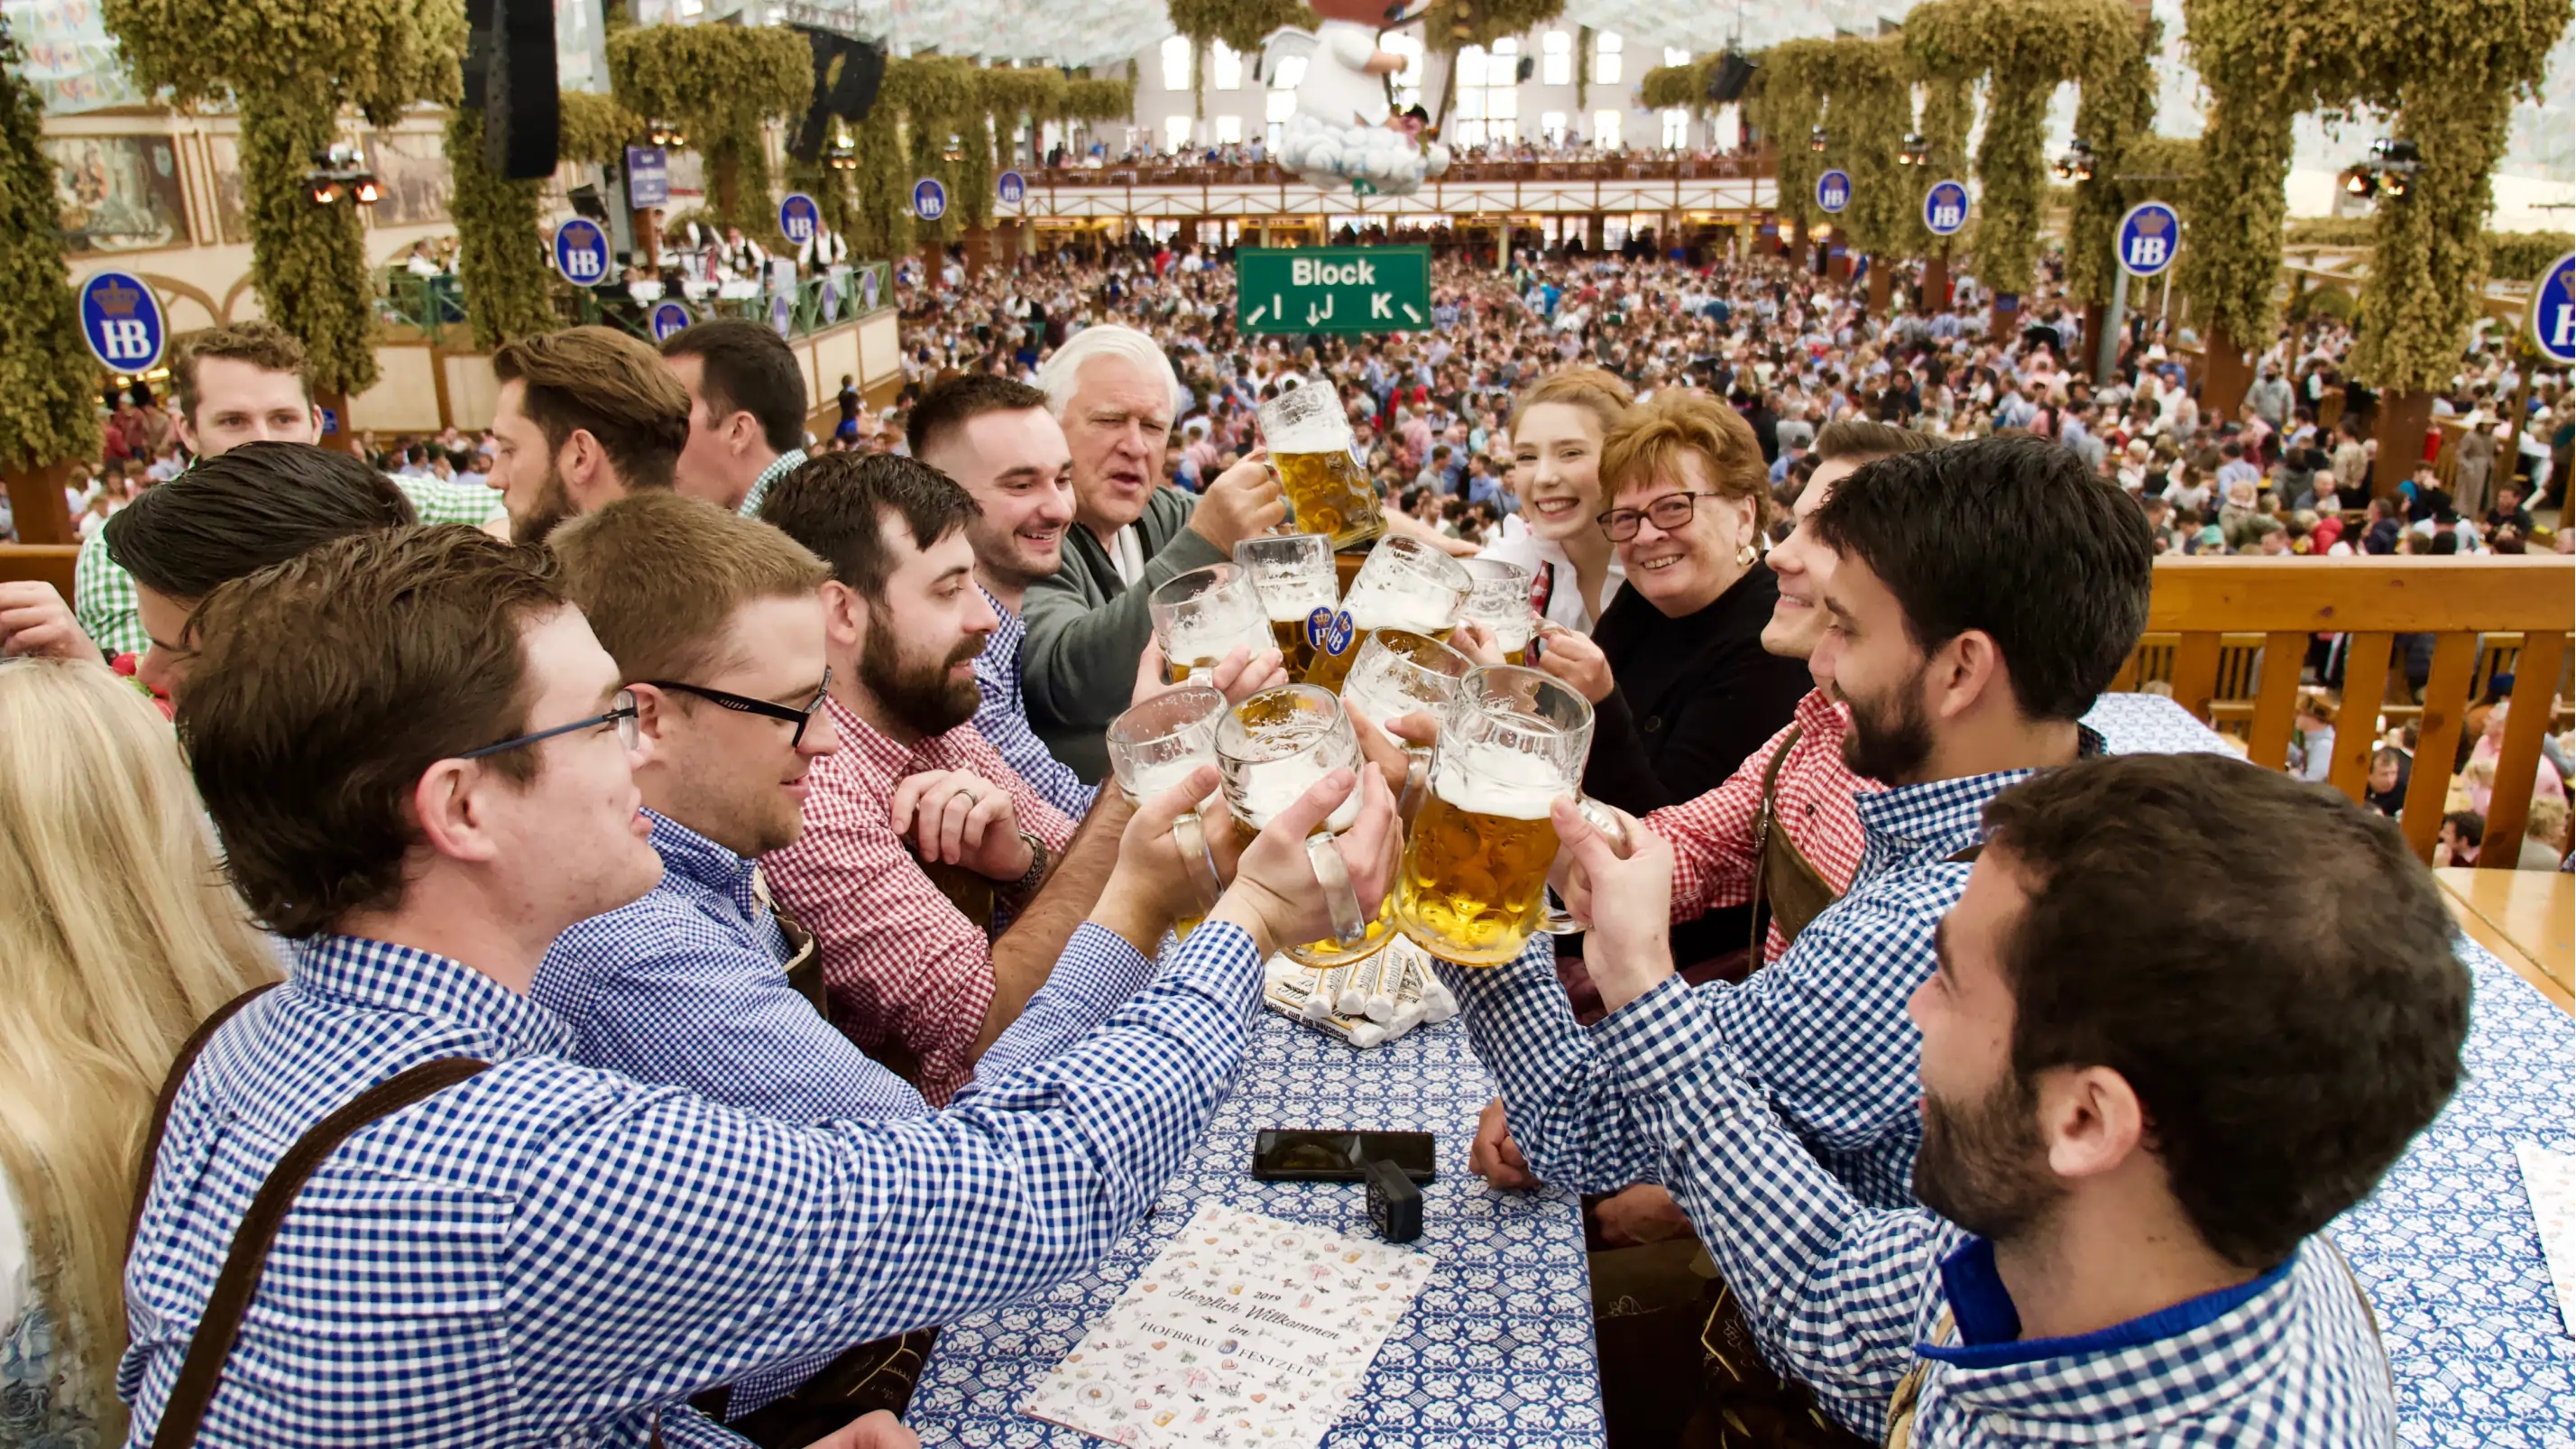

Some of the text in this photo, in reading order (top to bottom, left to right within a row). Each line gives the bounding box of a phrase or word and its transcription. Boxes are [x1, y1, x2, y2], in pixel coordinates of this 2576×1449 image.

[1003, 186, 1020, 200] HB
[1824, 189, 1845, 206] HB
[920, 198, 940, 215] HB
[1933, 206, 1960, 226] HB
[789, 218, 812, 237] HB
[2130, 237, 2167, 265] HB
[566, 249, 600, 276] HB
[1292, 258, 1375, 286] Block
[1274, 292, 1394, 319] I J K
[2551, 303, 2576, 346] H
[100, 319, 152, 358] HB
[1314, 627, 1329, 646] H
[1329, 626, 1344, 651] HB
[1288, 1010, 1301, 1022] uns
[1253, 1290, 1282, 1302] 2019
[1168, 1286, 1341, 1340] Herzlich Willkommen
[1228, 1324, 1251, 1336] im
[1139, 1322, 1215, 1348] HOFBRÄU
[1238, 1348, 1318, 1377] FESTZELT
